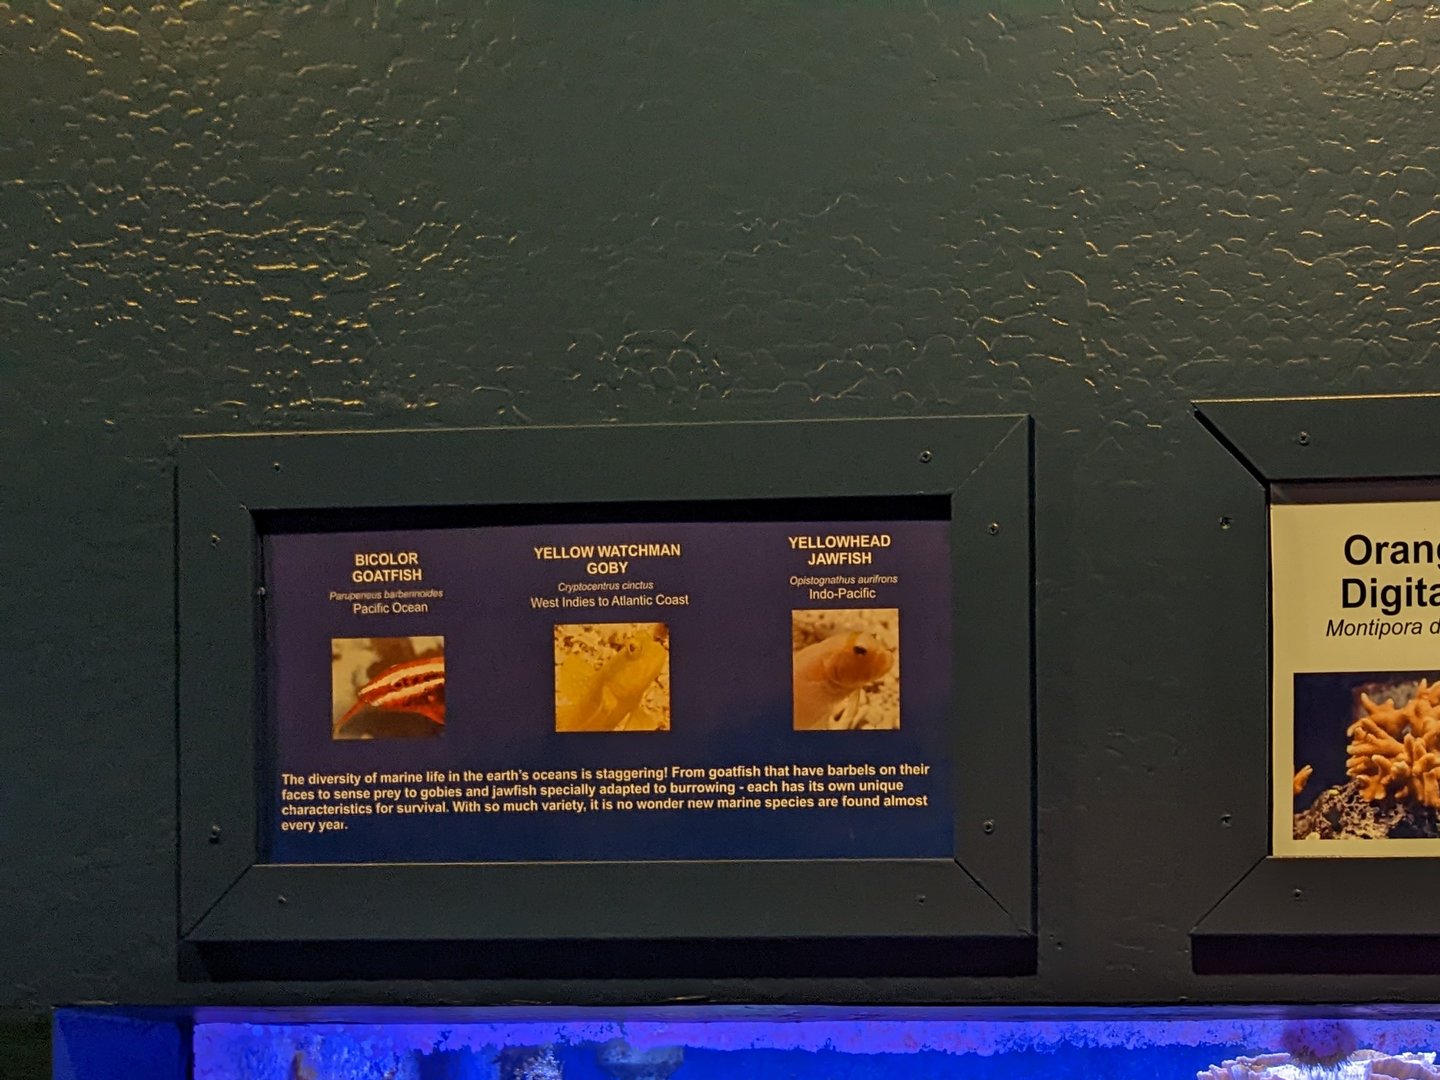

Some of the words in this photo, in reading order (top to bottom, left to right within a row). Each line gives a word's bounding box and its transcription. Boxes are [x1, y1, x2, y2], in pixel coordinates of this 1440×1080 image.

[788, 534, 891, 549] YELLOWHEAD
[534, 545, 594, 559] YELLOW
[597, 543, 680, 558] WATCHMAN
[807, 551, 872, 565] JAWFISH
[355, 552, 418, 566] BICOLOR
[586, 561, 628, 574] GOBY
[352, 568, 422, 583] GOATFISH
[789, 575, 856, 587] Opistognathus
[857, 574, 898, 584] aurifrons
[558, 581, 620, 594] Cryptocentrus
[621, 580, 654, 590] cinctus
[809, 587, 876, 599] Indo-Pacific
[329, 591, 382, 601] Parupeneus
[530, 597, 559, 608] West
[562, 596, 596, 607] Indies
[598, 596, 609, 607] to
[611, 594, 653, 606] Atlantic
[655, 593, 689, 605] Coast
[352, 602, 389, 614] Pacific
[391, 601, 428, 613] Ocean
[1325, 618, 1422, 640] Montipora
[281, 773, 305, 785] The
[308, 772, 361, 786] diversity
[364, 771, 378, 783] of
[380, 771, 423, 783] marine
[426, 770, 445, 782] life
[448, 770, 460, 782] in
[463, 770, 483, 782] the
[486, 769, 529, 781] earth's
[532, 770, 578, 780] oceans
[581, 767, 592, 779] is
[595, 766, 668, 782] staggering!
[671, 766, 705, 778] From
[708, 765, 761, 780] goatfish
[764, 765, 790, 777] that
[793, 764, 824, 776] have
[827, 763, 876, 776] barbels
[879, 766, 896, 775] on
[899, 763, 930, 775] their
[281, 788, 315, 800] faces
[317, 789, 330, 800] to
[333, 789, 370, 799] sense
[373, 789, 401, 801] prey
[404, 787, 417, 798] to
[419, 785, 462, 800] gobies
[465, 785, 489, 797] and
[491, 784, 537, 799] jawfish
[539, 783, 596, 798] specially
[599, 782, 650, 797] adapted
[653, 782, 667, 794] to
[670, 781, 735, 795] burrowing
[746, 780, 778, 792] each
[781, 780, 805, 792] has
[808, 780, 824, 792] its
[827, 782, 855, 791] own
[858, 779, 903, 793] unique
[281, 802, 372, 815] characteristics
[375, 802, 394, 814] for
[396, 800, 449, 813] survival.
[452, 800, 481, 812] With
[484, 802, 500, 812] so
[503, 799, 538, 811] much
[541, 799, 586, 813] variety,
[590, 798, 599, 810] it
[601, 798, 613, 810] is
[616, 800, 633, 809] no
[636, 797, 684, 809] wonder
[687, 799, 714, 808] new
[717, 796, 761, 808] marine
[764, 795, 814, 810] species
[817, 798, 838, 807] are
[841, 794, 880, 807] found
[883, 794, 928, 807] almost
[281, 821, 315, 833] every
[318, 820, 348, 833] year.
